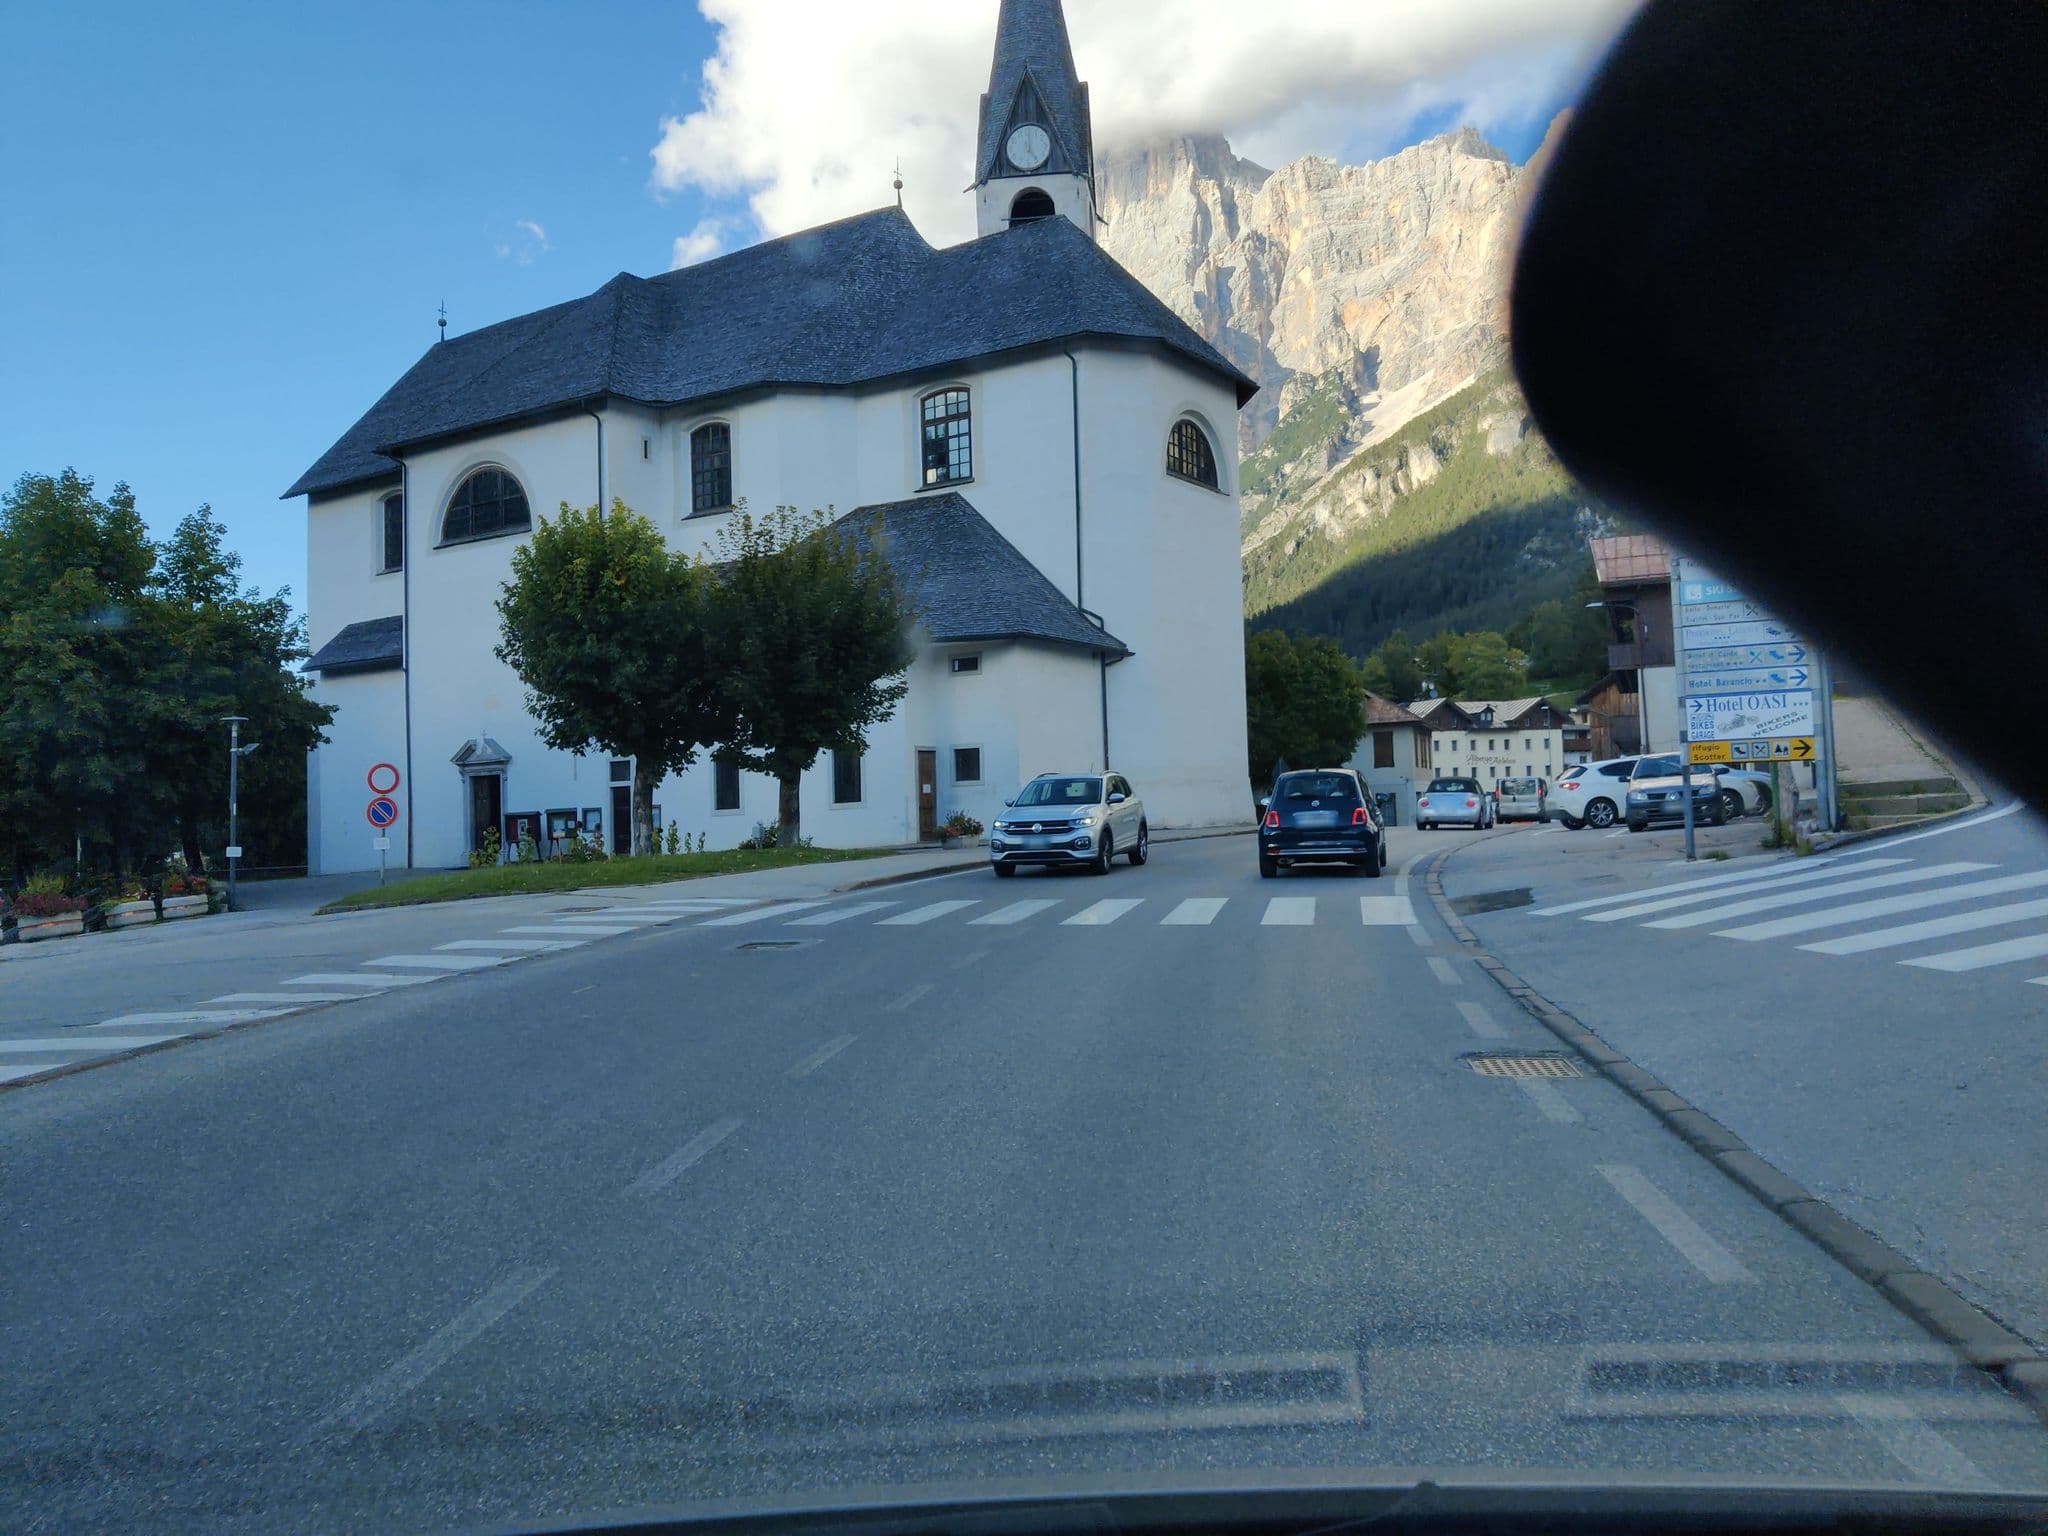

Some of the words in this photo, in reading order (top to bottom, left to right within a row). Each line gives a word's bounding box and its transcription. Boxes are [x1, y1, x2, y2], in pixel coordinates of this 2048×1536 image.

[1688, 679, 1712, 689] Hotel
[1706, 696, 1743, 713] Hotel
[1747, 694, 1787, 710] OASI
[1690, 720, 1715, 730] BIKES
[1751, 714, 1809, 737] WELCOME
[1756, 711, 1798, 729] BIKERS
[1693, 753, 1726, 761] Scotter
